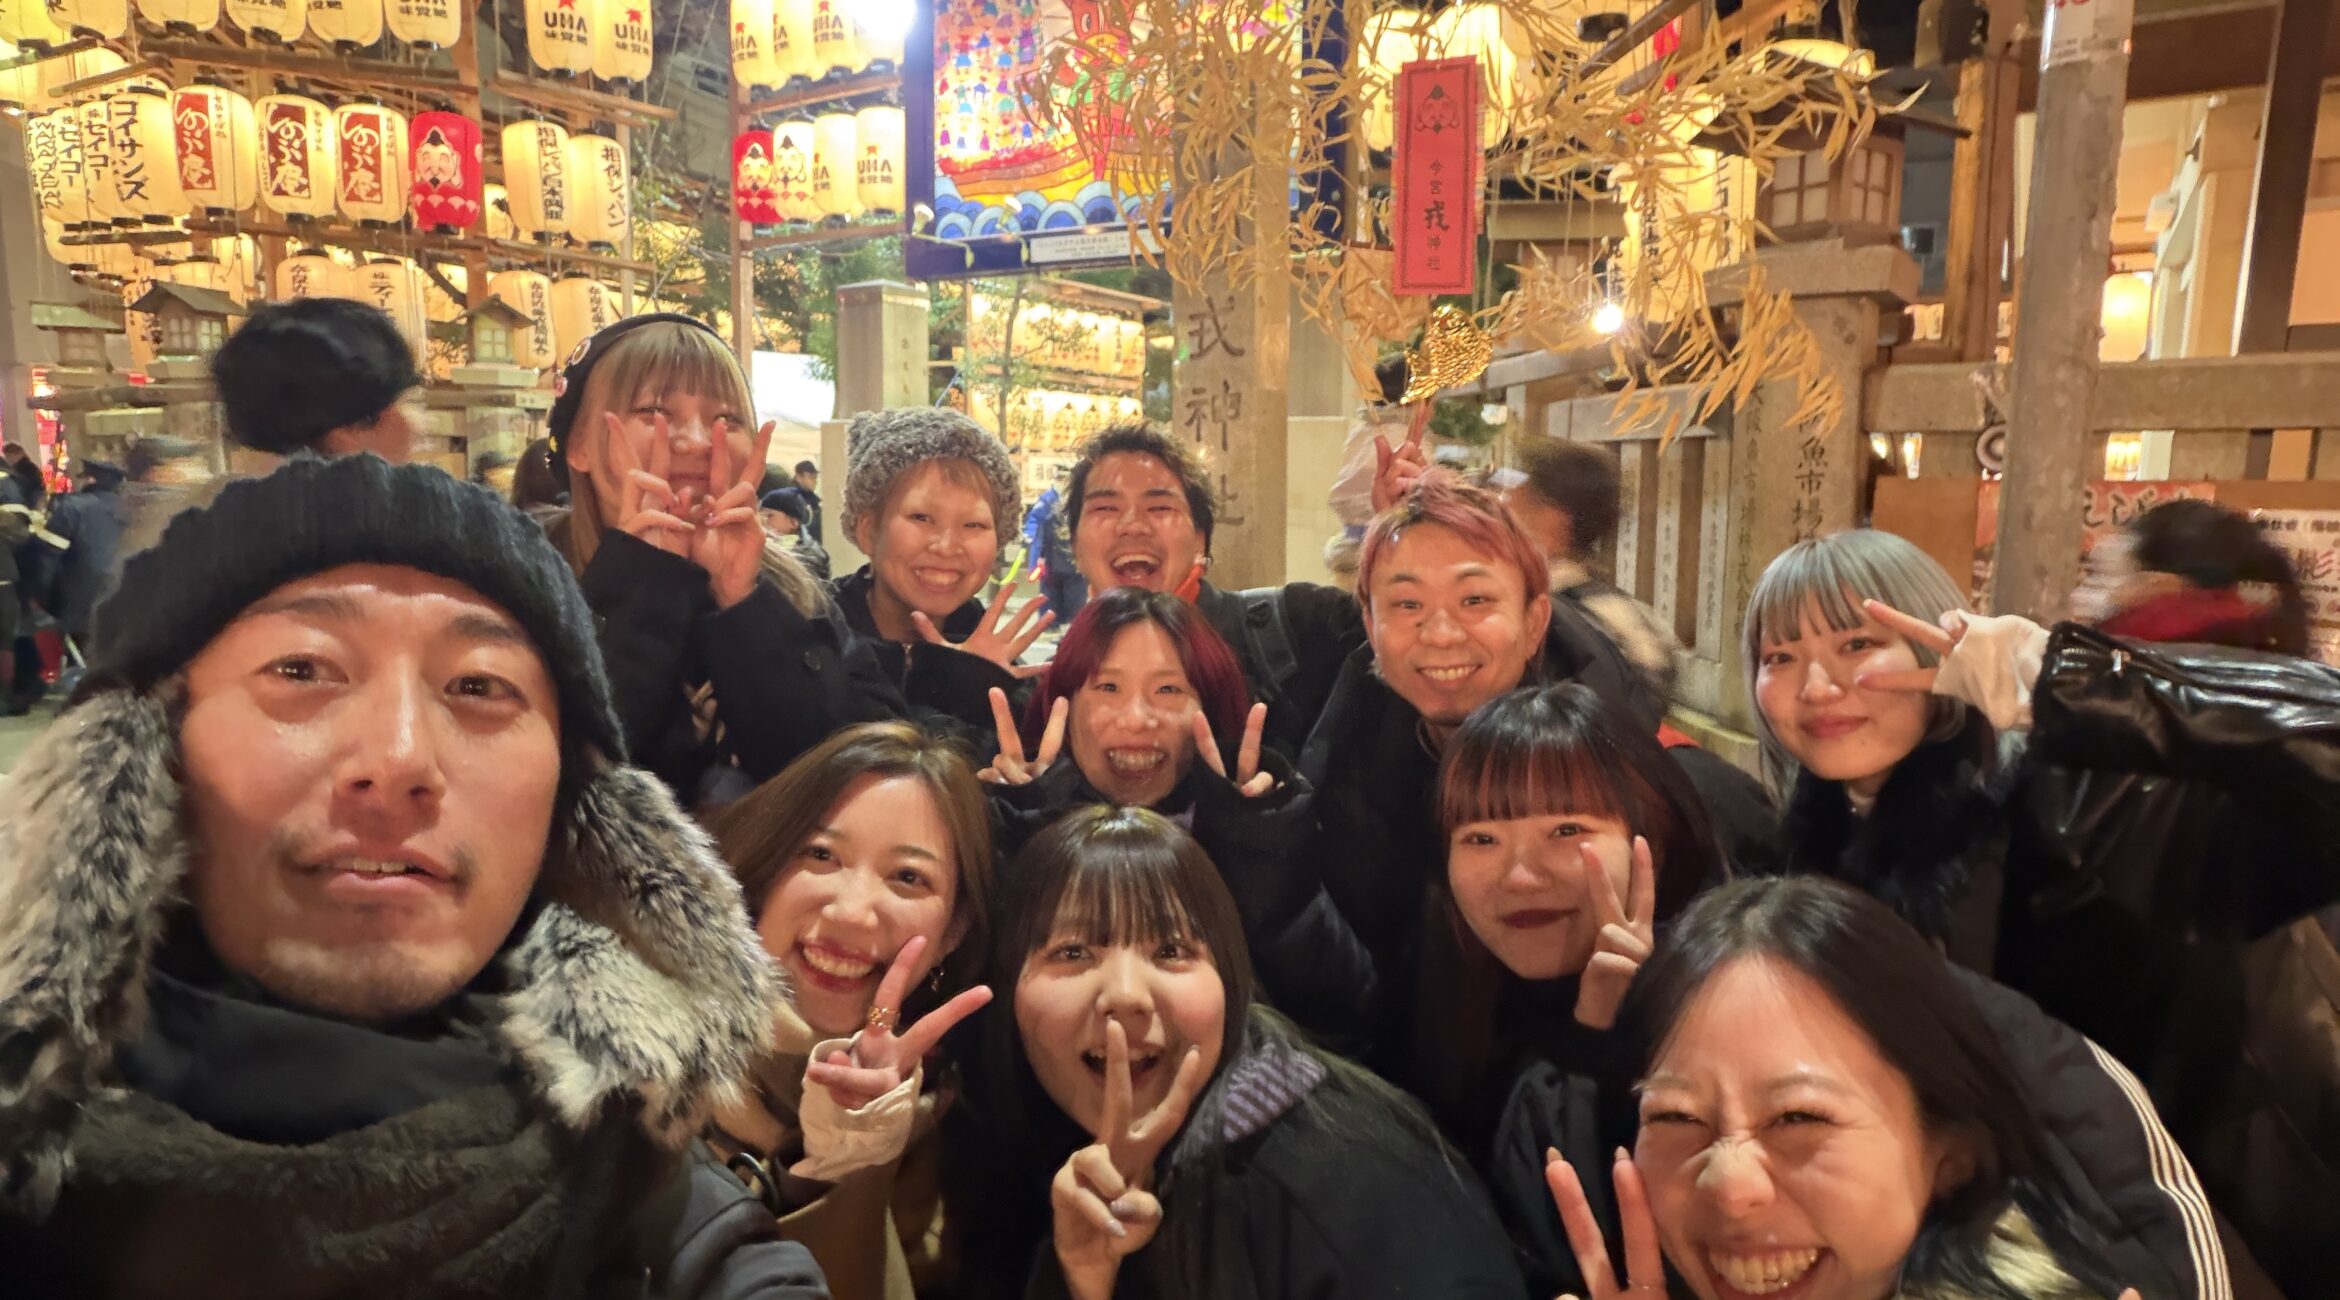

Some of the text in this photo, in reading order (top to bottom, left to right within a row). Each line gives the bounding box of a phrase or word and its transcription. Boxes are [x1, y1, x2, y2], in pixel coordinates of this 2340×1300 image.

[544, 11, 588, 33] UHA
[614, 23, 650, 43] UHA
[58, 126, 82, 188] セイコー
[84, 120, 109, 182] セイコー
[857, 158, 892, 175] UHA
[1793, 413, 1829, 548] 魚市場
